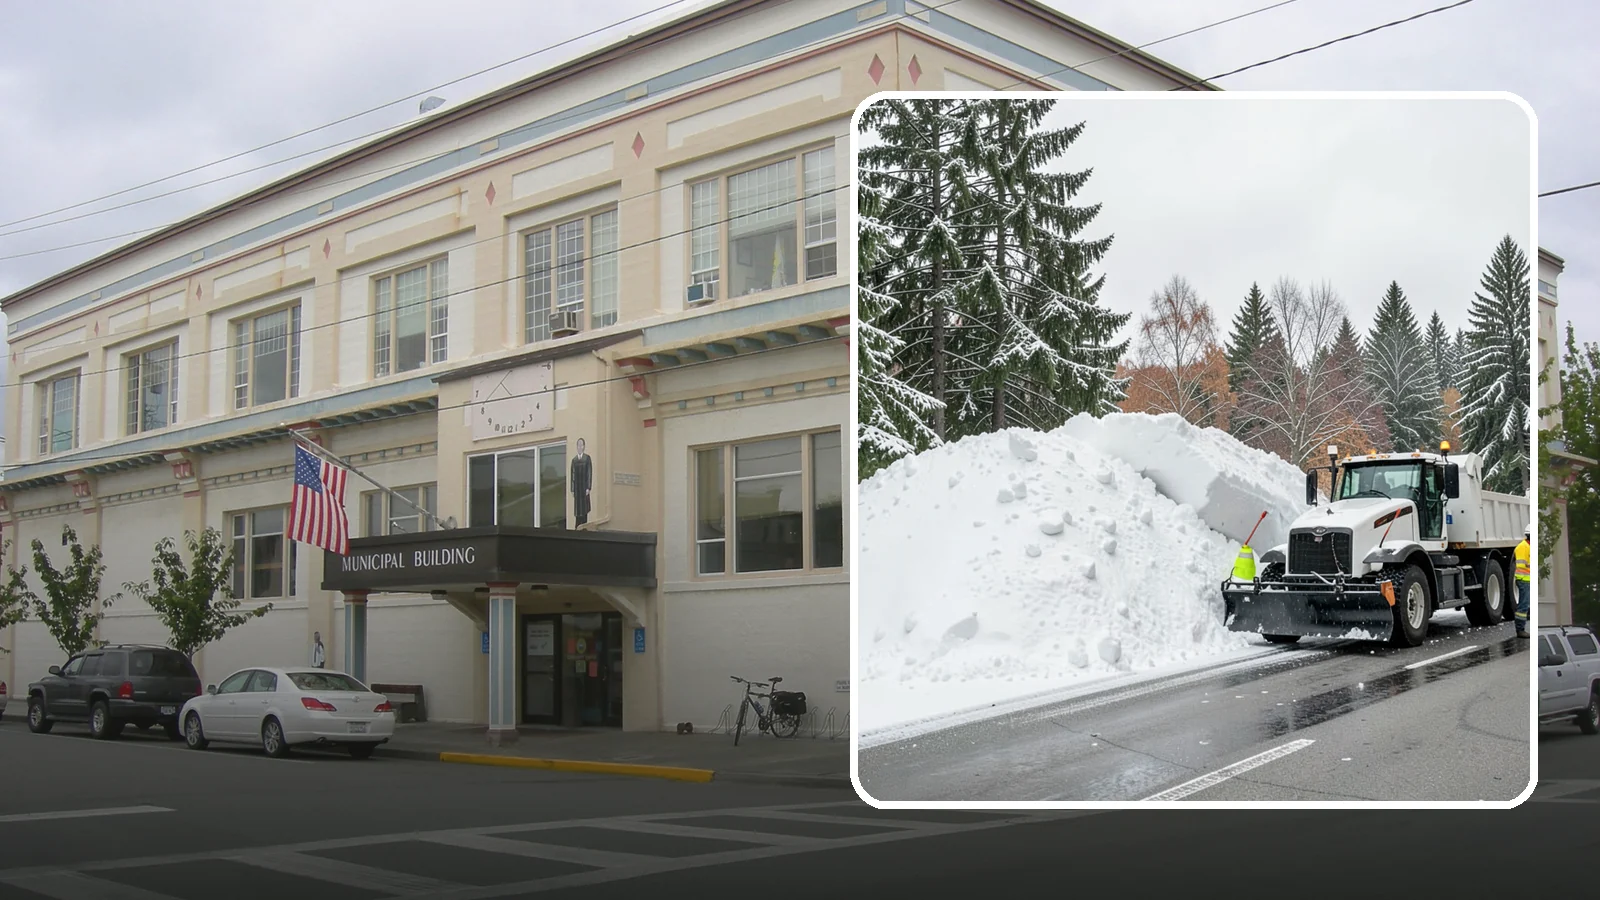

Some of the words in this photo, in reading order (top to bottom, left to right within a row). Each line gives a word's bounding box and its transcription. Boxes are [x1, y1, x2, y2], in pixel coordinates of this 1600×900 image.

[536, 402, 540, 410] 4
[481, 407, 485, 415] 8
[488, 418, 492, 426] 9
[529, 414, 533, 422] 3
[495, 424, 500, 432] 10
[521, 420, 525, 428] 2
[508, 425, 513, 433] 12
[342, 552, 405, 571] MUNICIPAL
[414, 546, 475, 567] BUILDING
